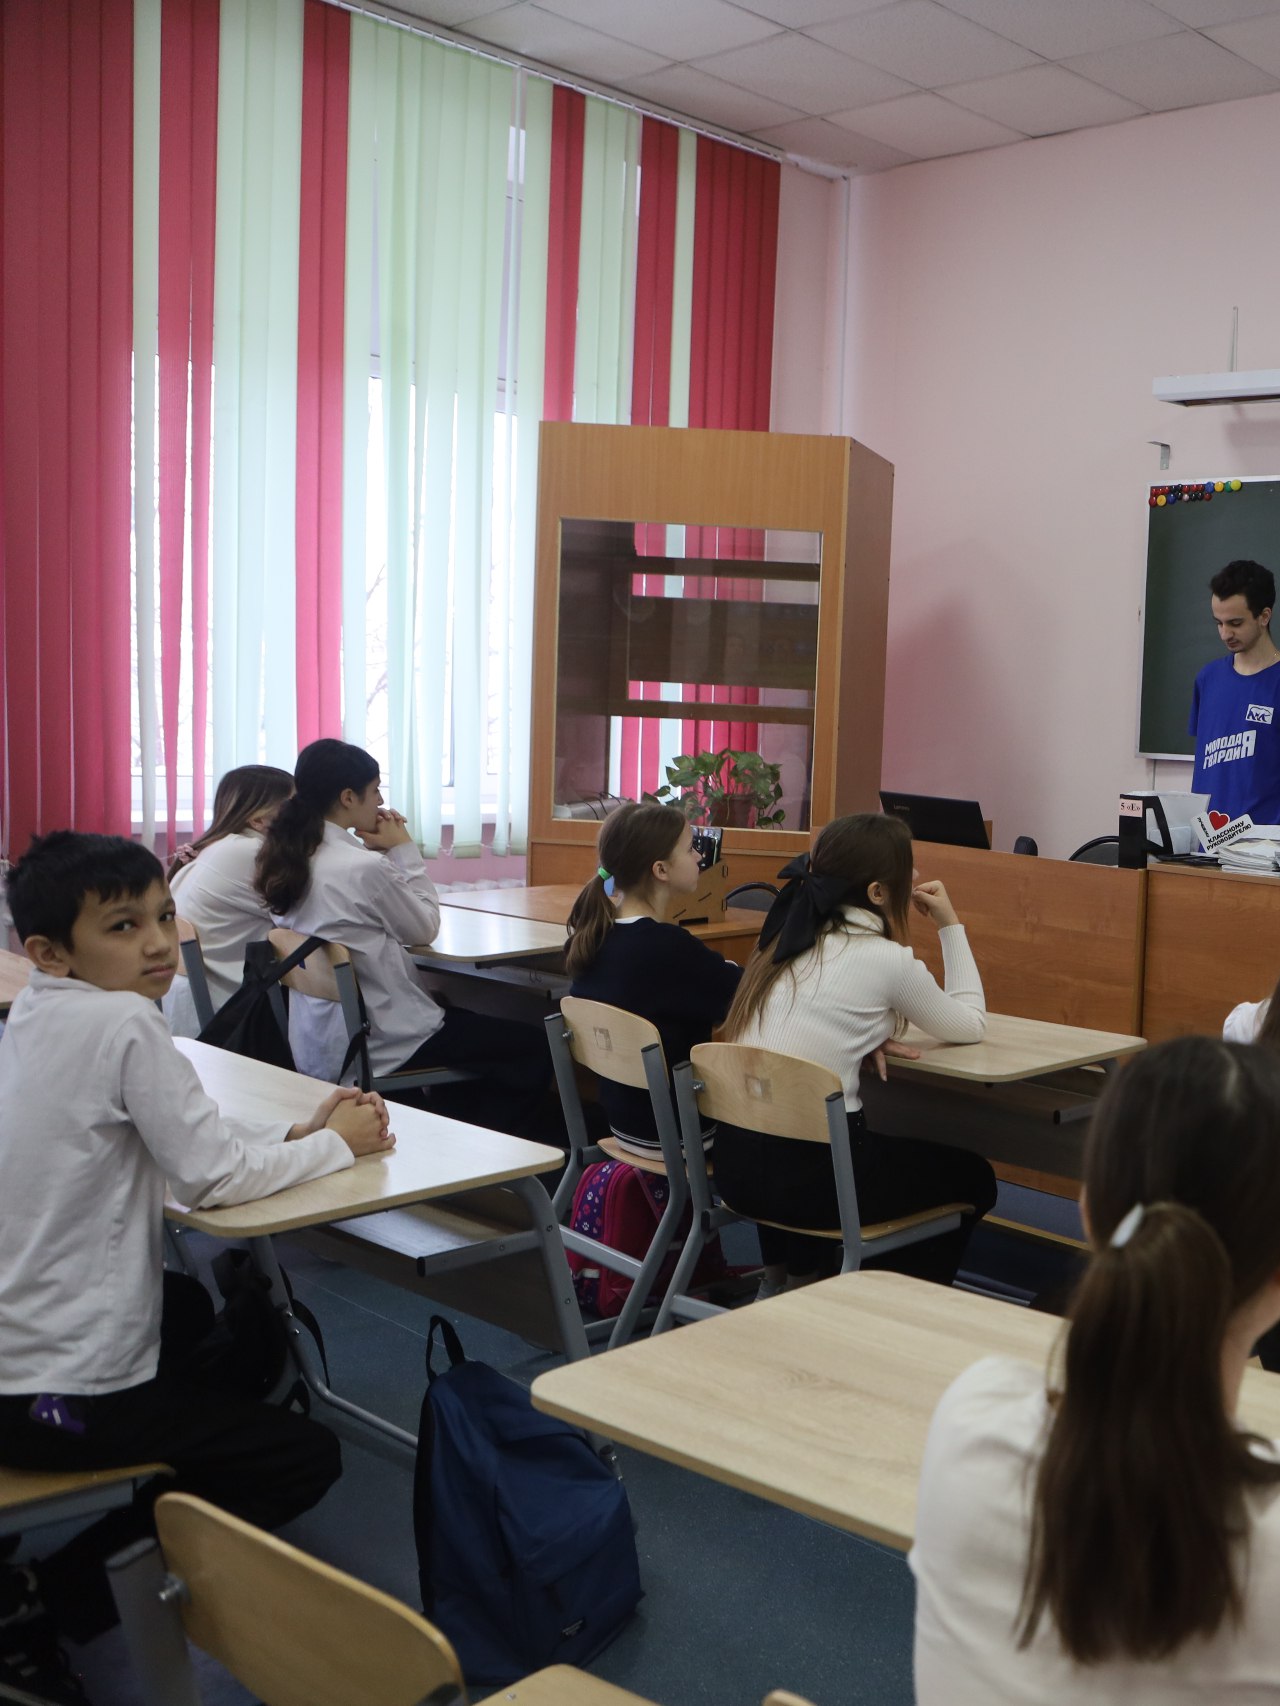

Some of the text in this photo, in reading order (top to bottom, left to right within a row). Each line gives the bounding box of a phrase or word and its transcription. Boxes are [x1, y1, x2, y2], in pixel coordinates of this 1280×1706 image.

[1120, 802, 1125, 810] 5
[1207, 824, 1251, 850] РУКОВОДИТЕЛЮ
[1208, 820, 1244, 843] КЛАССНОМУ
